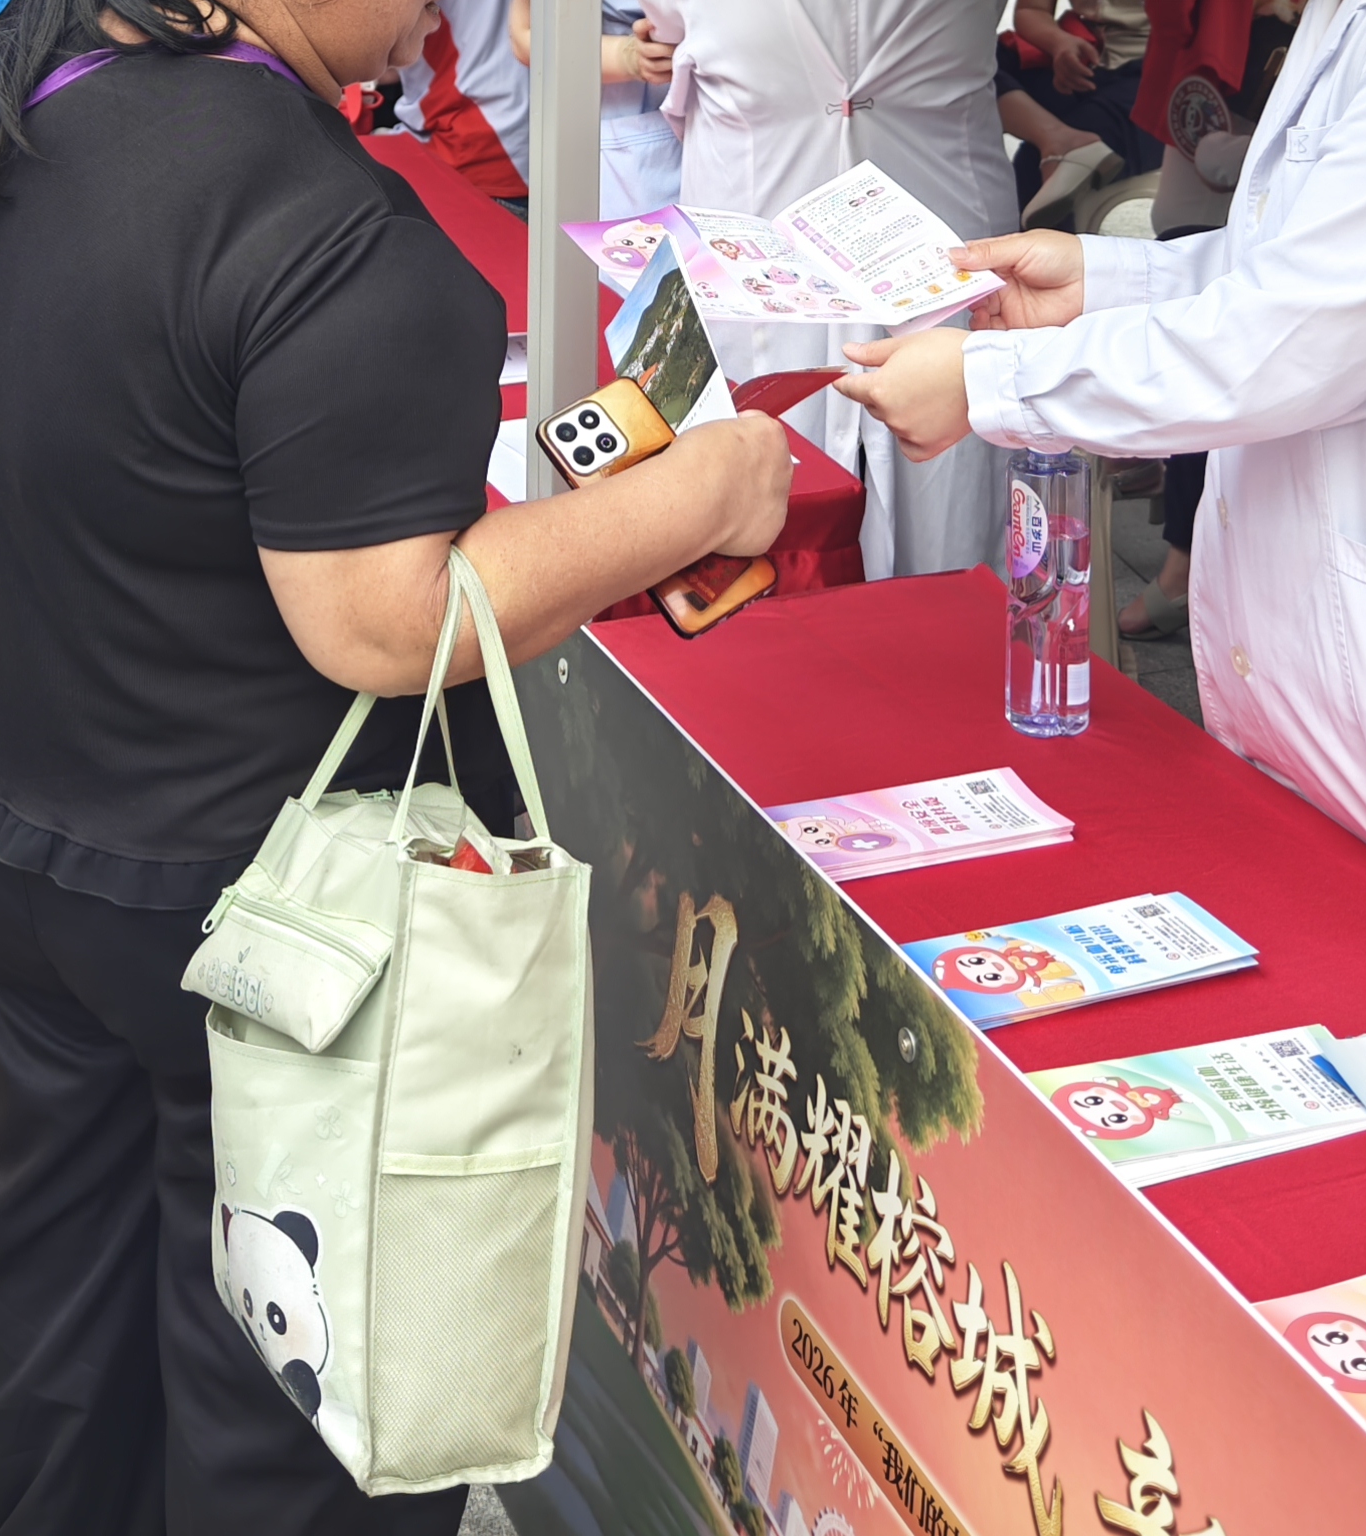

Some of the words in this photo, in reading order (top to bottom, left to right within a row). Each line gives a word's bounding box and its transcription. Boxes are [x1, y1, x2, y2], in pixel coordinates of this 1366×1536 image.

[1031, 516, 1042, 556] 百岁山
[1062, 922, 1127, 975] 单采血小板
[1089, 923, 1146, 966] 科普知识
[1196, 1064, 1254, 1112] 定期献血
[1209, 1050, 1292, 1122] 引领健康生活
